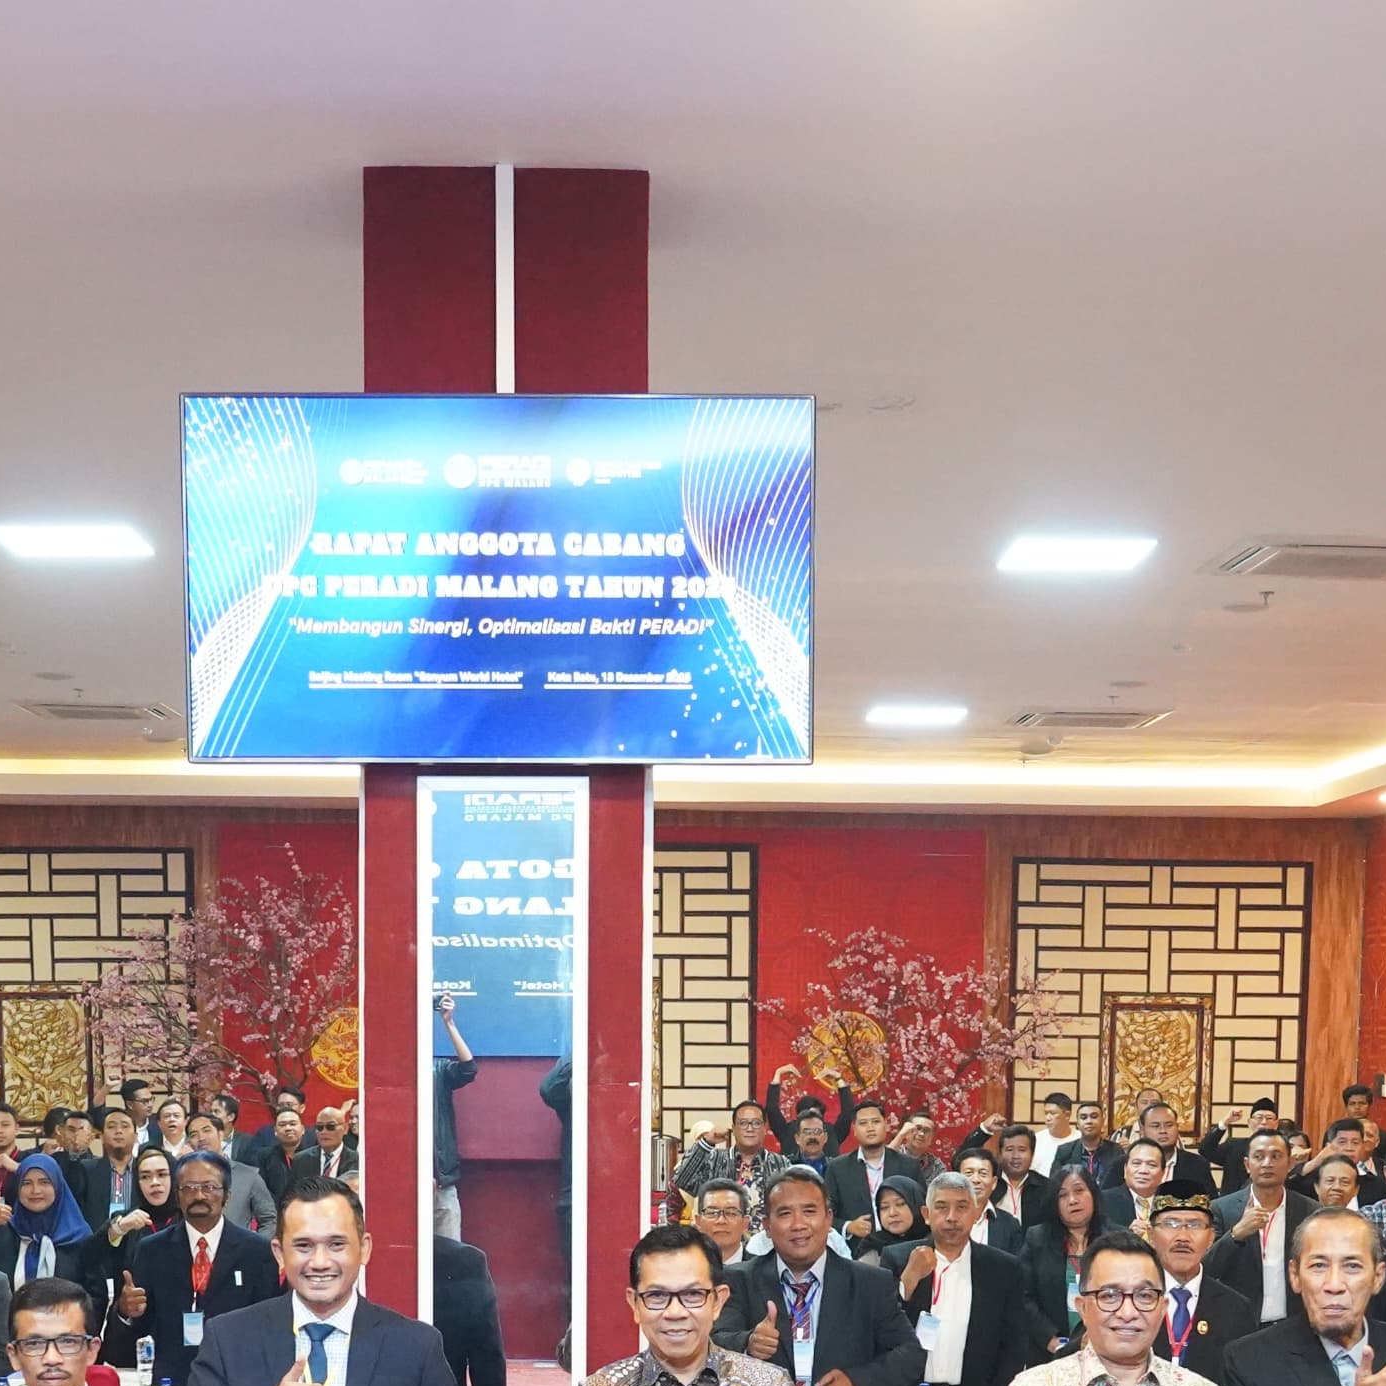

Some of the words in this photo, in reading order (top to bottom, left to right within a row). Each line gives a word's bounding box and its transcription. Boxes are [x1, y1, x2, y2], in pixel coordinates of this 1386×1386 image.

[311, 532, 408, 556] RAPAT
[415, 532, 557, 556] ANGGOTA
[563, 532, 685, 557] CABANG
[324, 575, 429, 598] PERADI
[435, 575, 559, 598] MALANG
[565, 575, 664, 598] TAHUN
[408, 617, 473, 638] Sinergi,
[478, 618, 584, 638] Optimalisasi
[589, 618, 635, 635] Bakti
